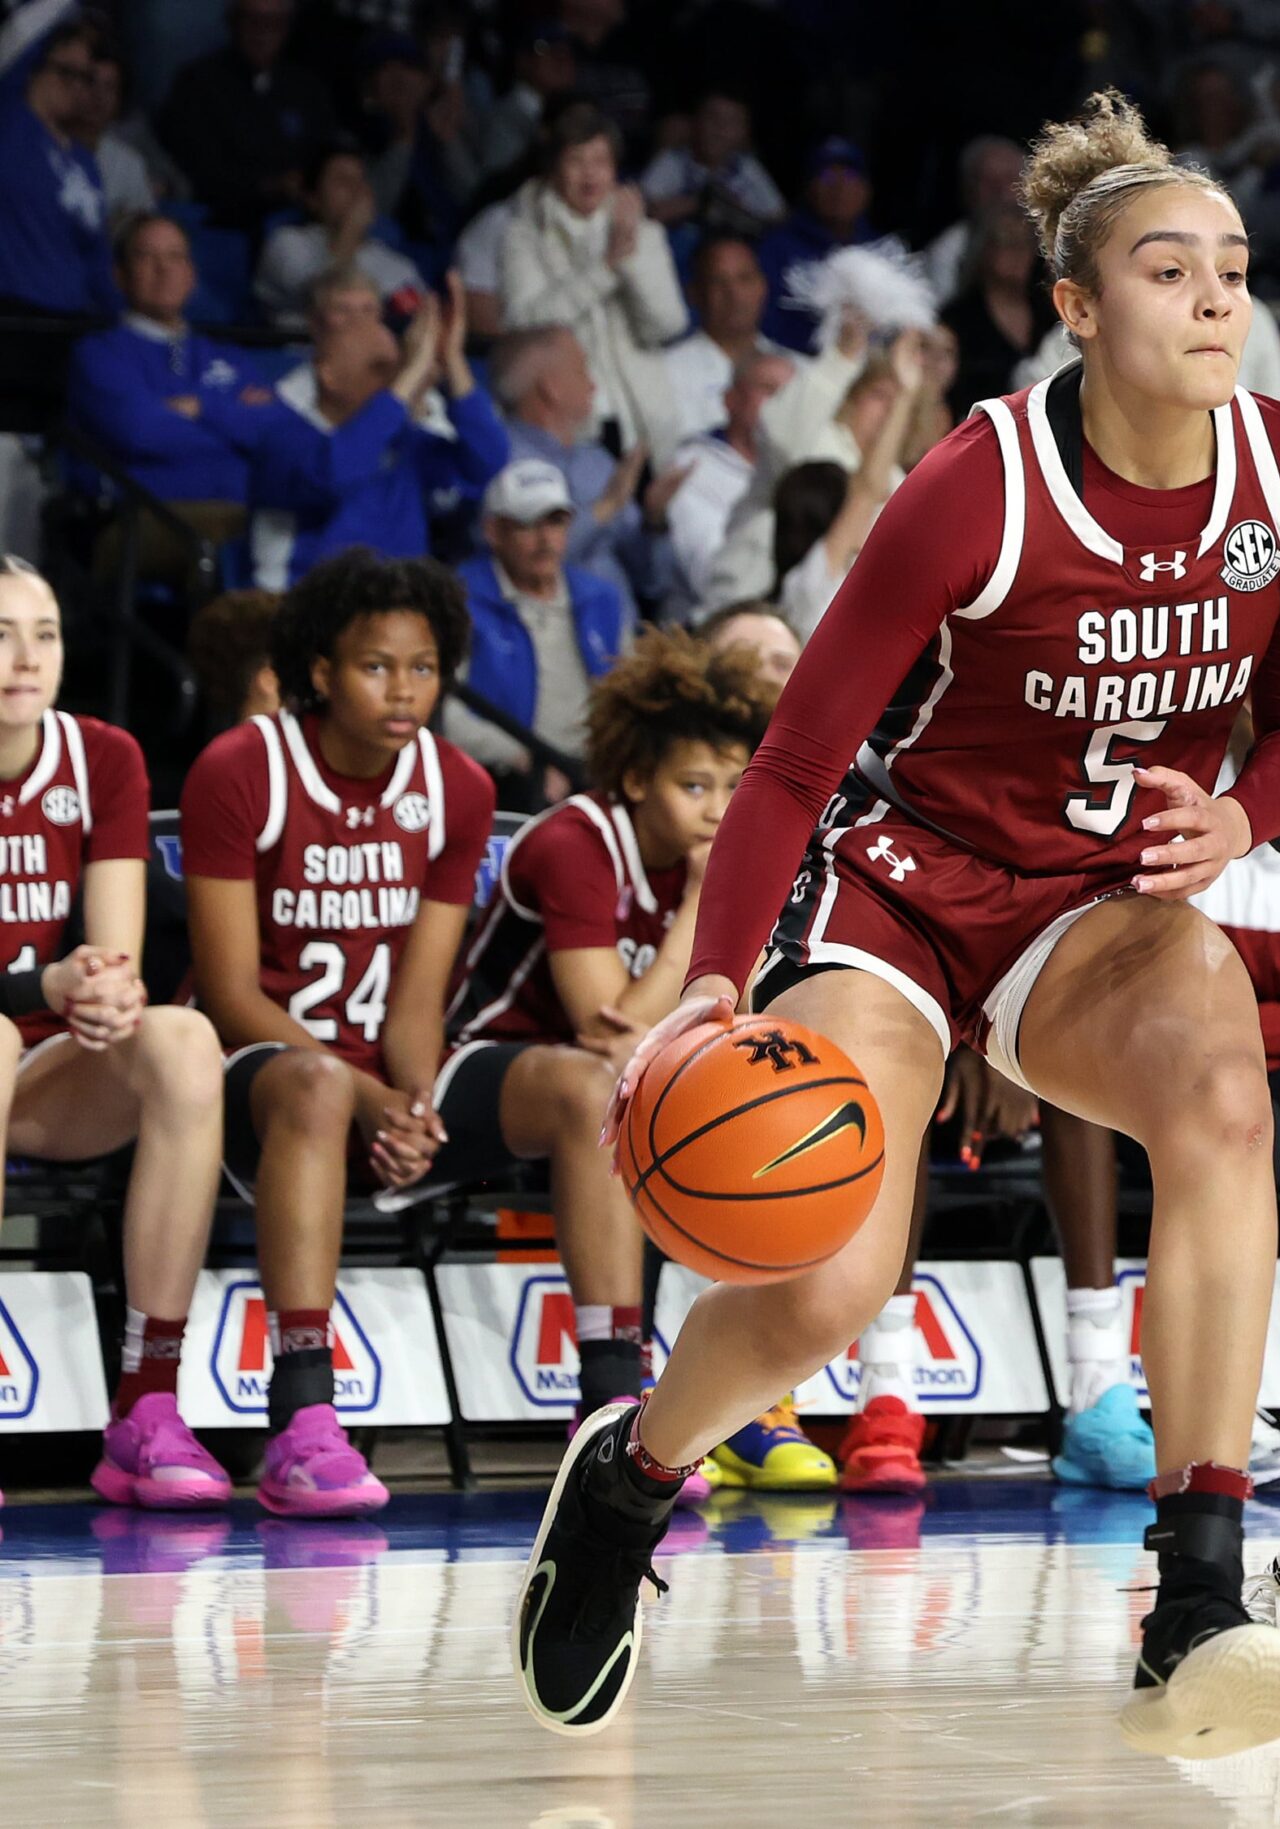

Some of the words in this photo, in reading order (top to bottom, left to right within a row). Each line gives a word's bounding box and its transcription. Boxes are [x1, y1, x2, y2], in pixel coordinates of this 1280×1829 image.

[1227, 523, 1272, 575] SEC
[1228, 562, 1280, 592] GRADUATE
[1077, 596, 1229, 665] SOUTH
[1024, 654, 1254, 722] CAROLINA
[1064, 719, 1168, 836] 5
[304, 841, 403, 885] SOUTH
[0, 880, 71, 923] LINA
[288, 941, 395, 1042] 24
